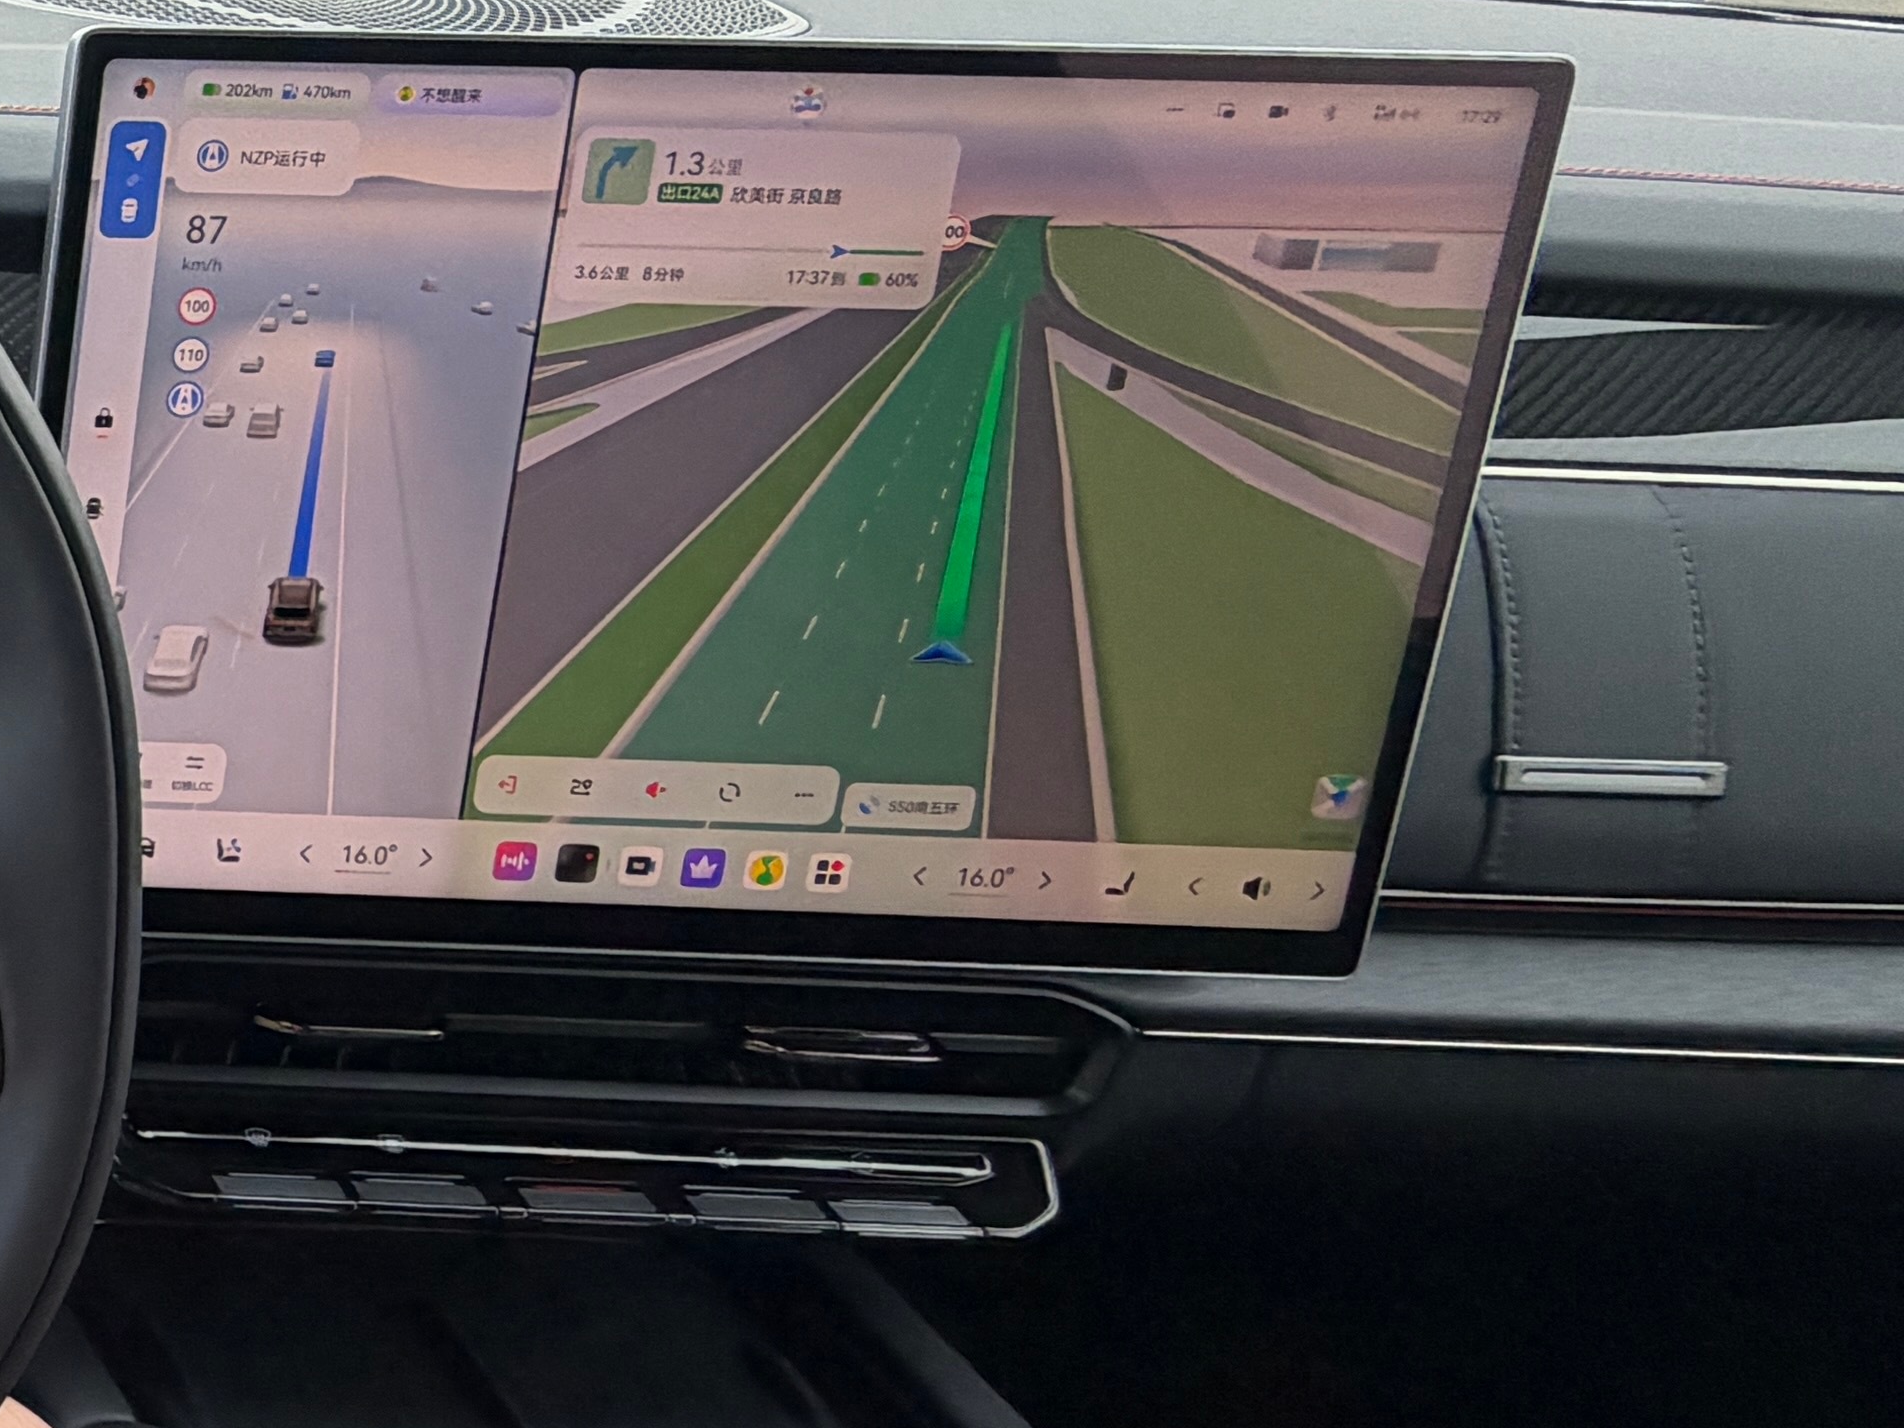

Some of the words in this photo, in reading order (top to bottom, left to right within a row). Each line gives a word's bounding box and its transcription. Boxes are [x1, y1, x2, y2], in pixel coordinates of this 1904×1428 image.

[225, 83, 273, 99] 202km
[303, 85, 351, 101] 470km
[420, 87, 482, 104] 不想醒来
[240, 149, 326, 168] NZP运行中
[661, 185, 720, 202] 出口24A
[186, 215, 228, 245] 87
[182, 257, 223, 272] km/h
[575, 265, 630, 282] 3.6公里
[885, 272, 919, 288] 60%
[184, 299, 210, 313] 100
[179, 348, 204, 362] 110
